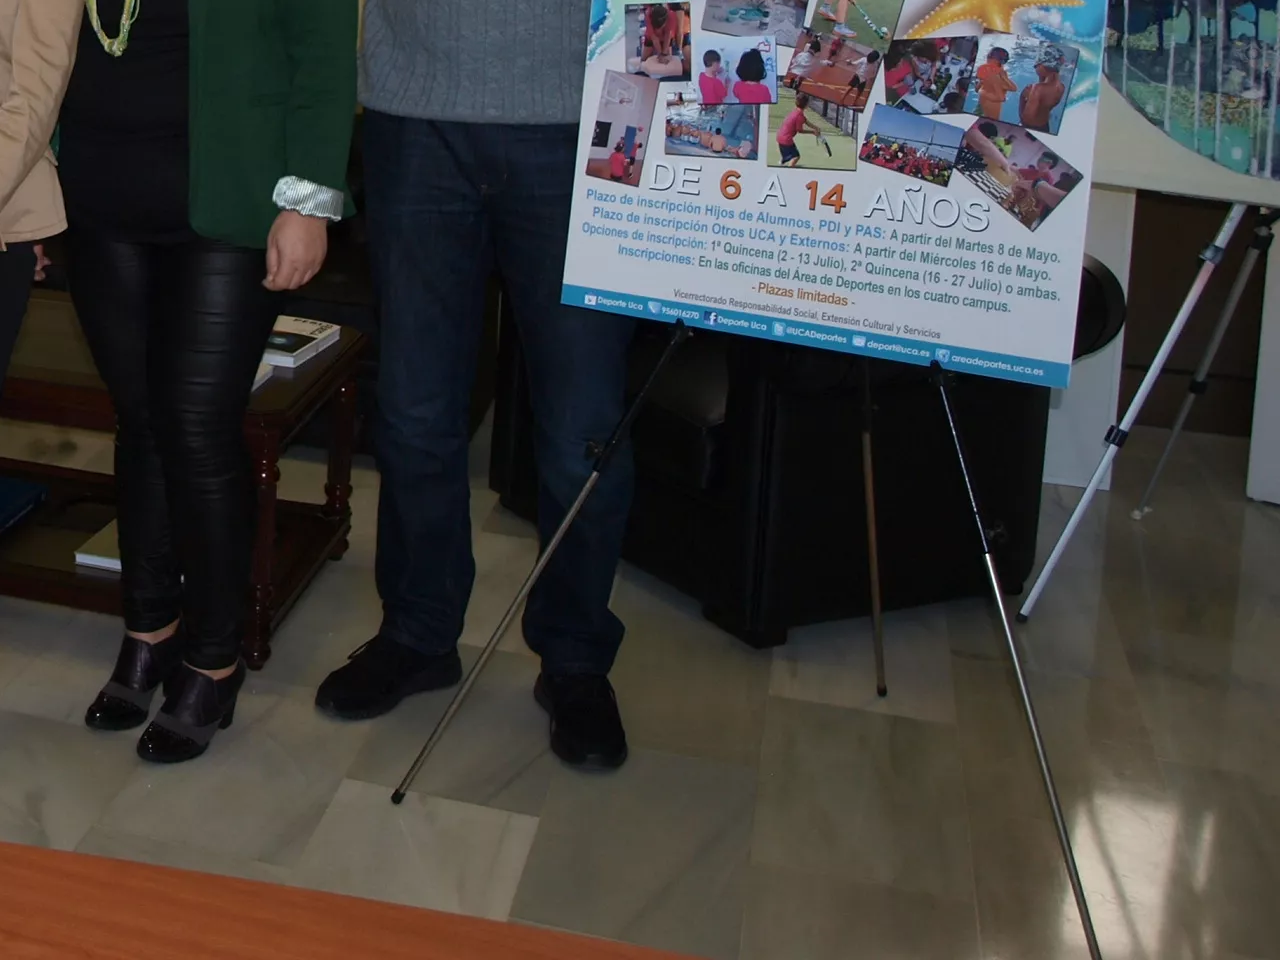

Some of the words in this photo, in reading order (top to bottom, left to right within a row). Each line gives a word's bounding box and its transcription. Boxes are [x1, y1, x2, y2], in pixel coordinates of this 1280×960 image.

[648, 162, 702, 196] DE
[719, 169, 742, 201] 6
[757, 174, 787, 207] A
[805, 180, 847, 214] 14
[865, 182, 992, 233] AÑOS
[586, 189, 616, 203] Plazo
[619, 193, 633, 205] de
[636, 196, 701, 214] inscripción
[704, 205, 734, 220] Hijos
[738, 209, 753, 221] de
[755, 212, 814, 231] Alumnos,
[818, 220, 840, 233] PDI
[843, 226, 851, 237] y
[855, 225, 886, 239] PAS:
[889, 230, 898, 241] A
[900, 234, 932, 246] partir
[934, 236, 952, 249] del
[954, 239, 994, 254] Martes
[997, 245, 1004, 256] 8
[1007, 246, 1022, 258] de
[1025, 249, 1060, 264] Mayo.
[592, 206, 622, 220] Plazo
[626, 211, 640, 223] de
[643, 213, 708, 232] inscripción
[711, 223, 744, 237] Otros
[748, 228, 775, 242] UCA
[778, 235, 786, 245] y
[789, 234, 850, 252] Externos:
[852, 243, 862, 254] A
[864, 246, 896, 259] partir
[898, 249, 916, 261] del
[919, 252, 976, 270] Miércoles
[980, 260, 994, 272] 16
[997, 263, 1012, 275] de
[1015, 265, 1051, 280] Mayo.
[582, 221, 628, 238] Opciones
[631, 229, 643, 240] de
[646, 231, 707, 249] inscripción:
[711, 240, 721, 251] 1ª
[723, 242, 774, 259] Quincena
[776, 250, 787, 263] (2
[798, 253, 810, 264] 13
[812, 255, 847, 271] Julio),
[850, 260, 862, 272] 2ª
[864, 262, 919, 280] Quincena
[922, 271, 940, 284] (16
[950, 275, 965, 287] 27
[967, 277, 1002, 294] Julio)
[1005, 285, 1013, 293] o
[1016, 286, 1060, 300] ambas.
[618, 244, 695, 265] Inscripciones:
[698, 256, 712, 268] En
[714, 258, 728, 270] las
[731, 261, 771, 276] oficinas
[774, 267, 790, 279] del
[791, 267, 817, 283] Área
[819, 274, 833, 286] de
[835, 276, 884, 293] Deportes
[886, 286, 900, 296] en
[904, 286, 920, 299] los
[923, 292, 959, 305] cuatro
[962, 298, 1010, 312] campus.
[597, 296, 627, 307] Deporte
[628, 301, 643, 310] Uca
[661, 306, 699, 319] 956016270
[672, 288, 727, 305] Vicerrectorado
[728, 297, 792, 315] Responsabilidad
[792, 307, 819, 320] Social,
[820, 312, 860, 326] Extensión
[862, 318, 894, 331] Cultural
[895, 325, 901, 334] y
[902, 325, 940, 339] Servicios
[757, 282, 794, 298] Plazas
[796, 288, 848, 306] limitadas
[717, 315, 748, 327] Deporte
[750, 320, 767, 330] Uca
[951, 355, 1043, 375] areadeportes.uca.es
